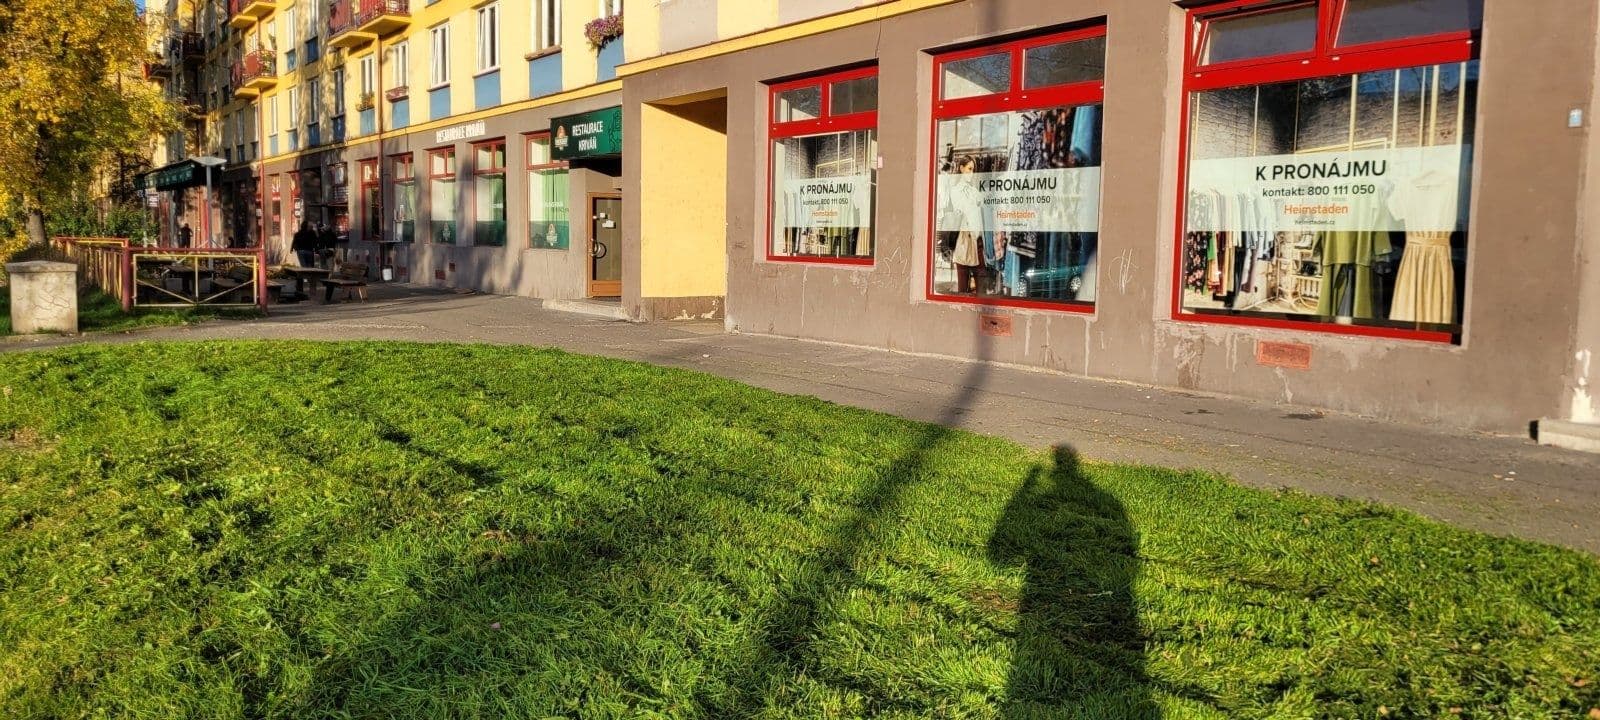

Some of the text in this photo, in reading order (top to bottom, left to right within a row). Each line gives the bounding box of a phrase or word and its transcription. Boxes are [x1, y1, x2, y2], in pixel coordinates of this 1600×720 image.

[572, 121, 603, 136] RESTAURACE
[1256, 157, 1386, 181] K PRONÁJMU
[800, 181, 852, 195] K PRONÁJMU
[979, 175, 1057, 192] K PRONÁJMU
[1262, 184, 1375, 197] kontakt: 800 111 050
[839, 197, 849, 205] 050
[983, 195, 1051, 205] kontakt: 800 111 050
[996, 210, 1035, 219] Heimstaden
[1284, 203, 1348, 214] Heimstaden
